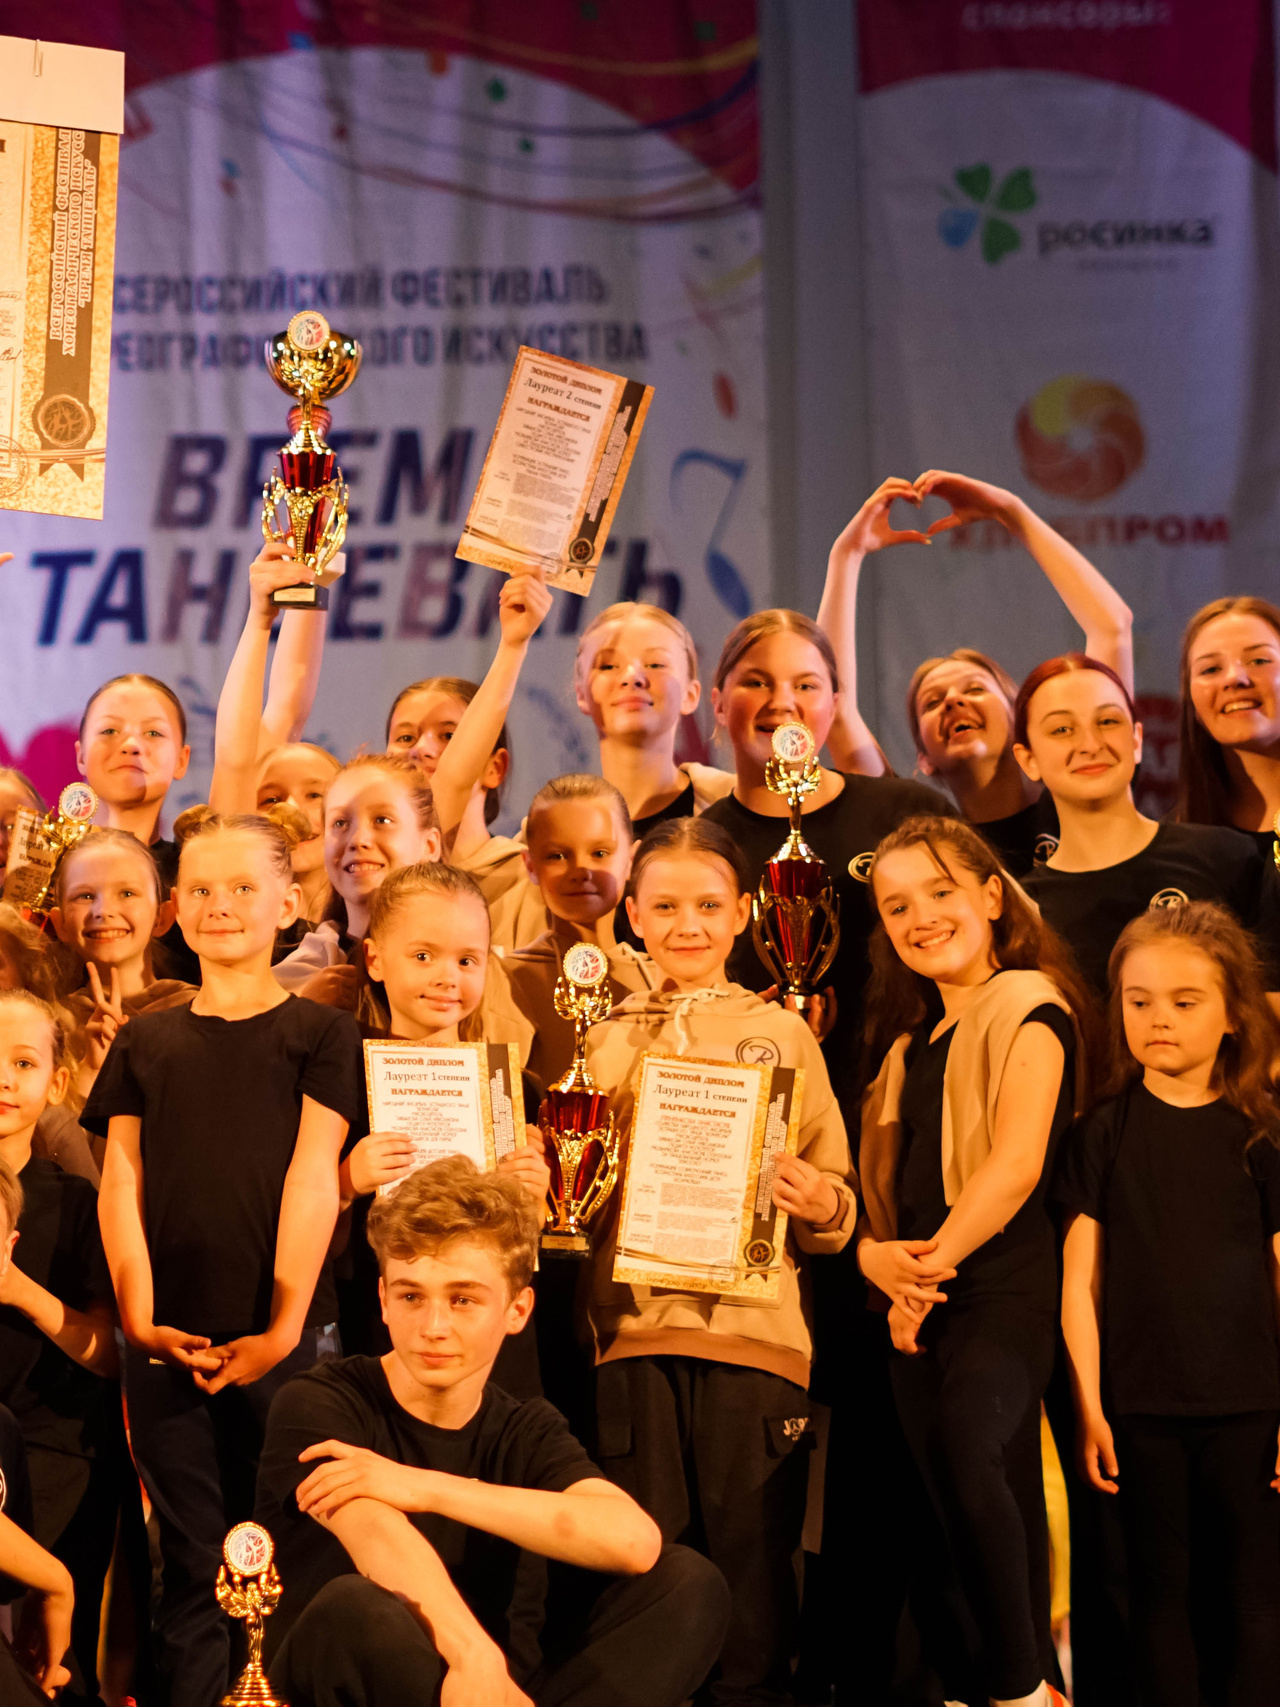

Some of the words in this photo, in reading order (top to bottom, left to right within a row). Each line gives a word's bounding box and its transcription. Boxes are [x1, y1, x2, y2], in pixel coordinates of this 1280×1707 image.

[56, 127, 71, 211] ФЕСТИВАЛ
[70, 128, 85, 191] ИСКУСС
[1038, 219, 1214, 259] росинка
[49, 210, 68, 341] ВСЕРОССИЙСКИЙ
[62, 190, 82, 357] ХОРЕОГРАФИЧЕСКОГО
[113, 268, 384, 315] СЕРОССИЙСКИЙ
[390, 263, 608, 309] ФЕСТИВАЛЬ
[530, 366, 568, 384] ЗОЛОТОЙ
[523, 377, 565, 397] Лауреат
[566, 390, 572, 400] 2
[527, 396, 590, 422] НАГРАЖДАЕТСЯ
[382, 1057, 424, 1066] ЗОЛОТОЙ
[426, 1058, 465, 1067] ДИПЛОМ
[384, 1071, 428, 1083] Лауреат
[657, 1070, 701, 1083] ЗОЛОТОЙ
[703, 1076, 745, 1088] ДИПЛОМ
[390, 1088, 463, 1097] НАГРАЖДАЕТСЯ
[653, 1084, 701, 1098] Лауреат
[704, 1090, 710, 1100] 1
[713, 1093, 748, 1103] степени
[659, 1102, 736, 1118] НАГРАЖДАЕТСЯ
